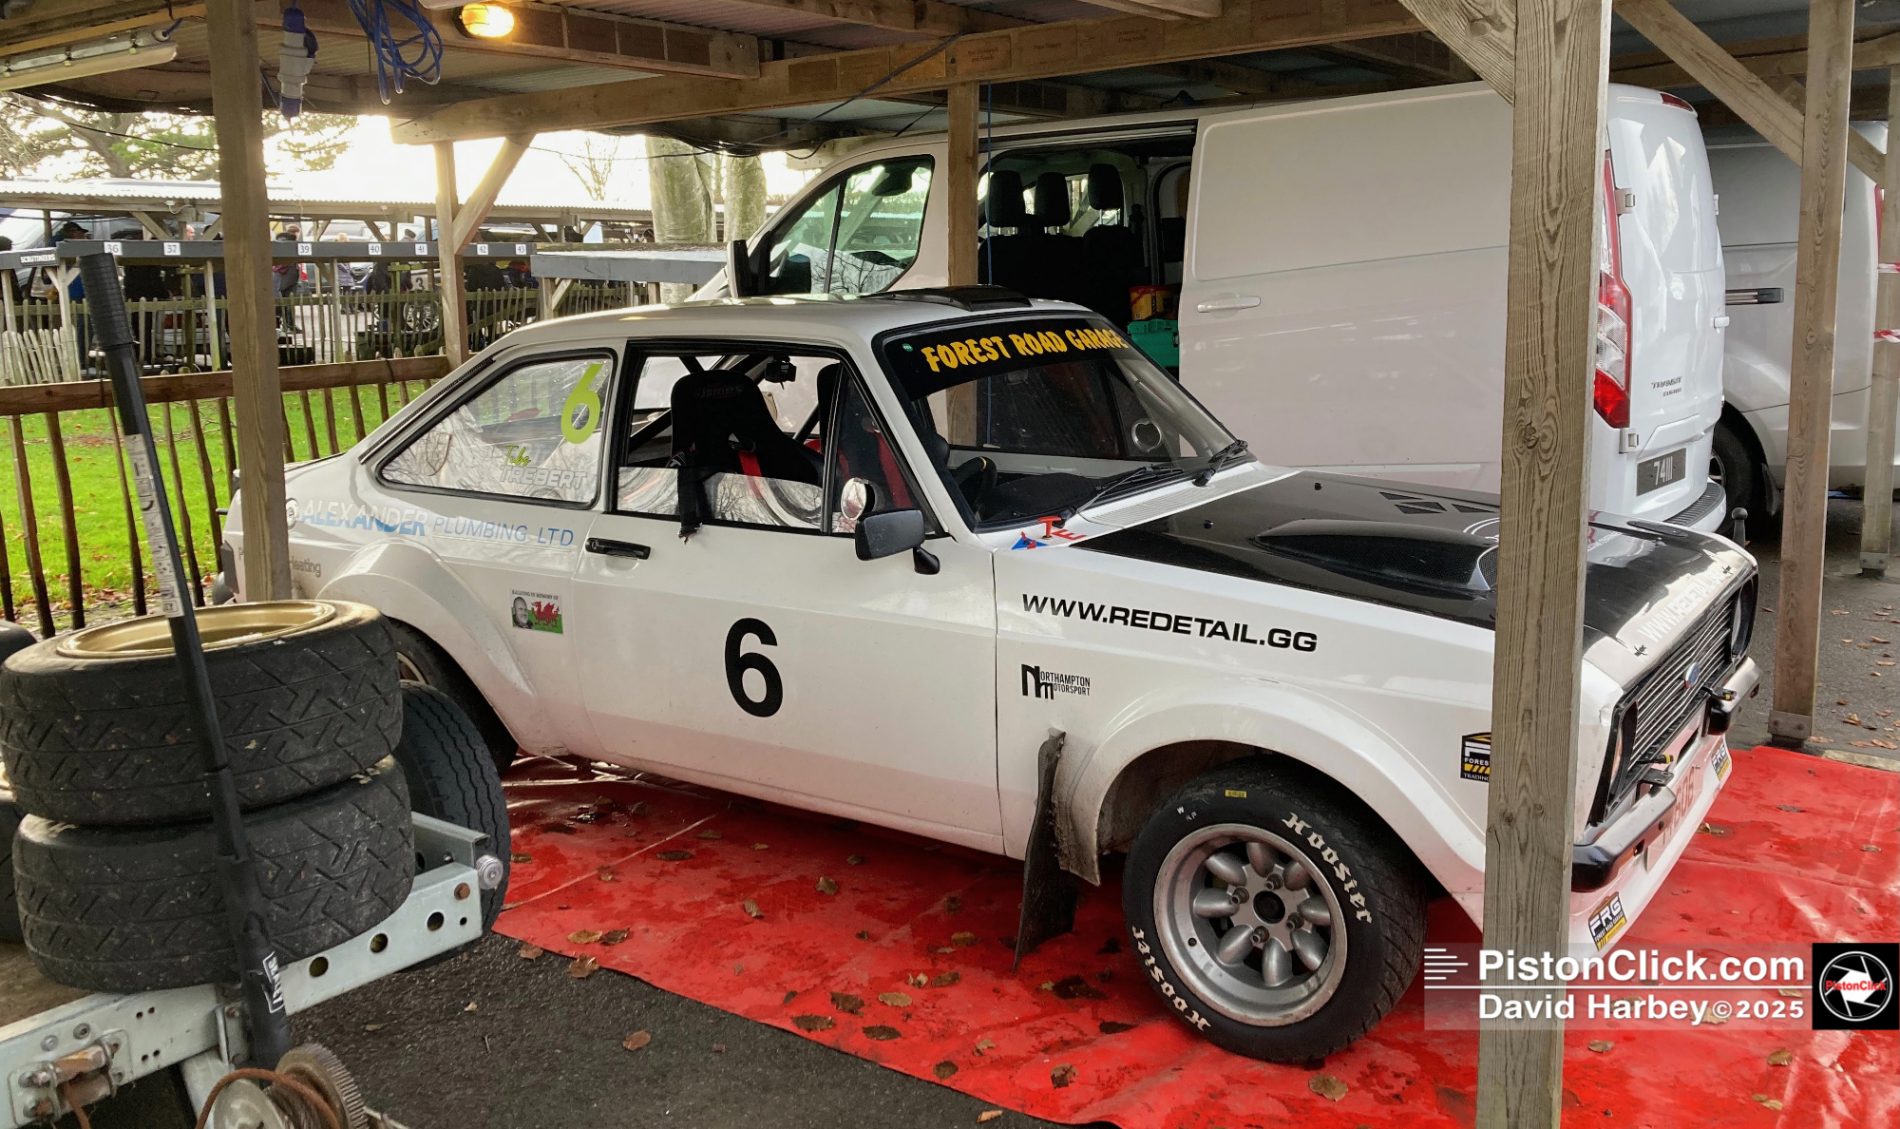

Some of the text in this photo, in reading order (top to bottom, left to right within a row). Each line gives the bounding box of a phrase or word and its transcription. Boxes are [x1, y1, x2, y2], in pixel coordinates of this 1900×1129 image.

[920, 328, 1129, 373] FOREST ROAD GARAGE
[561, 363, 604, 445] 6
[299, 499, 575, 547] ALEXANDER PLUMBING LTD
[1022, 593, 1318, 653] WWW.REDETAIL.GG
[724, 617, 784, 718] 6
